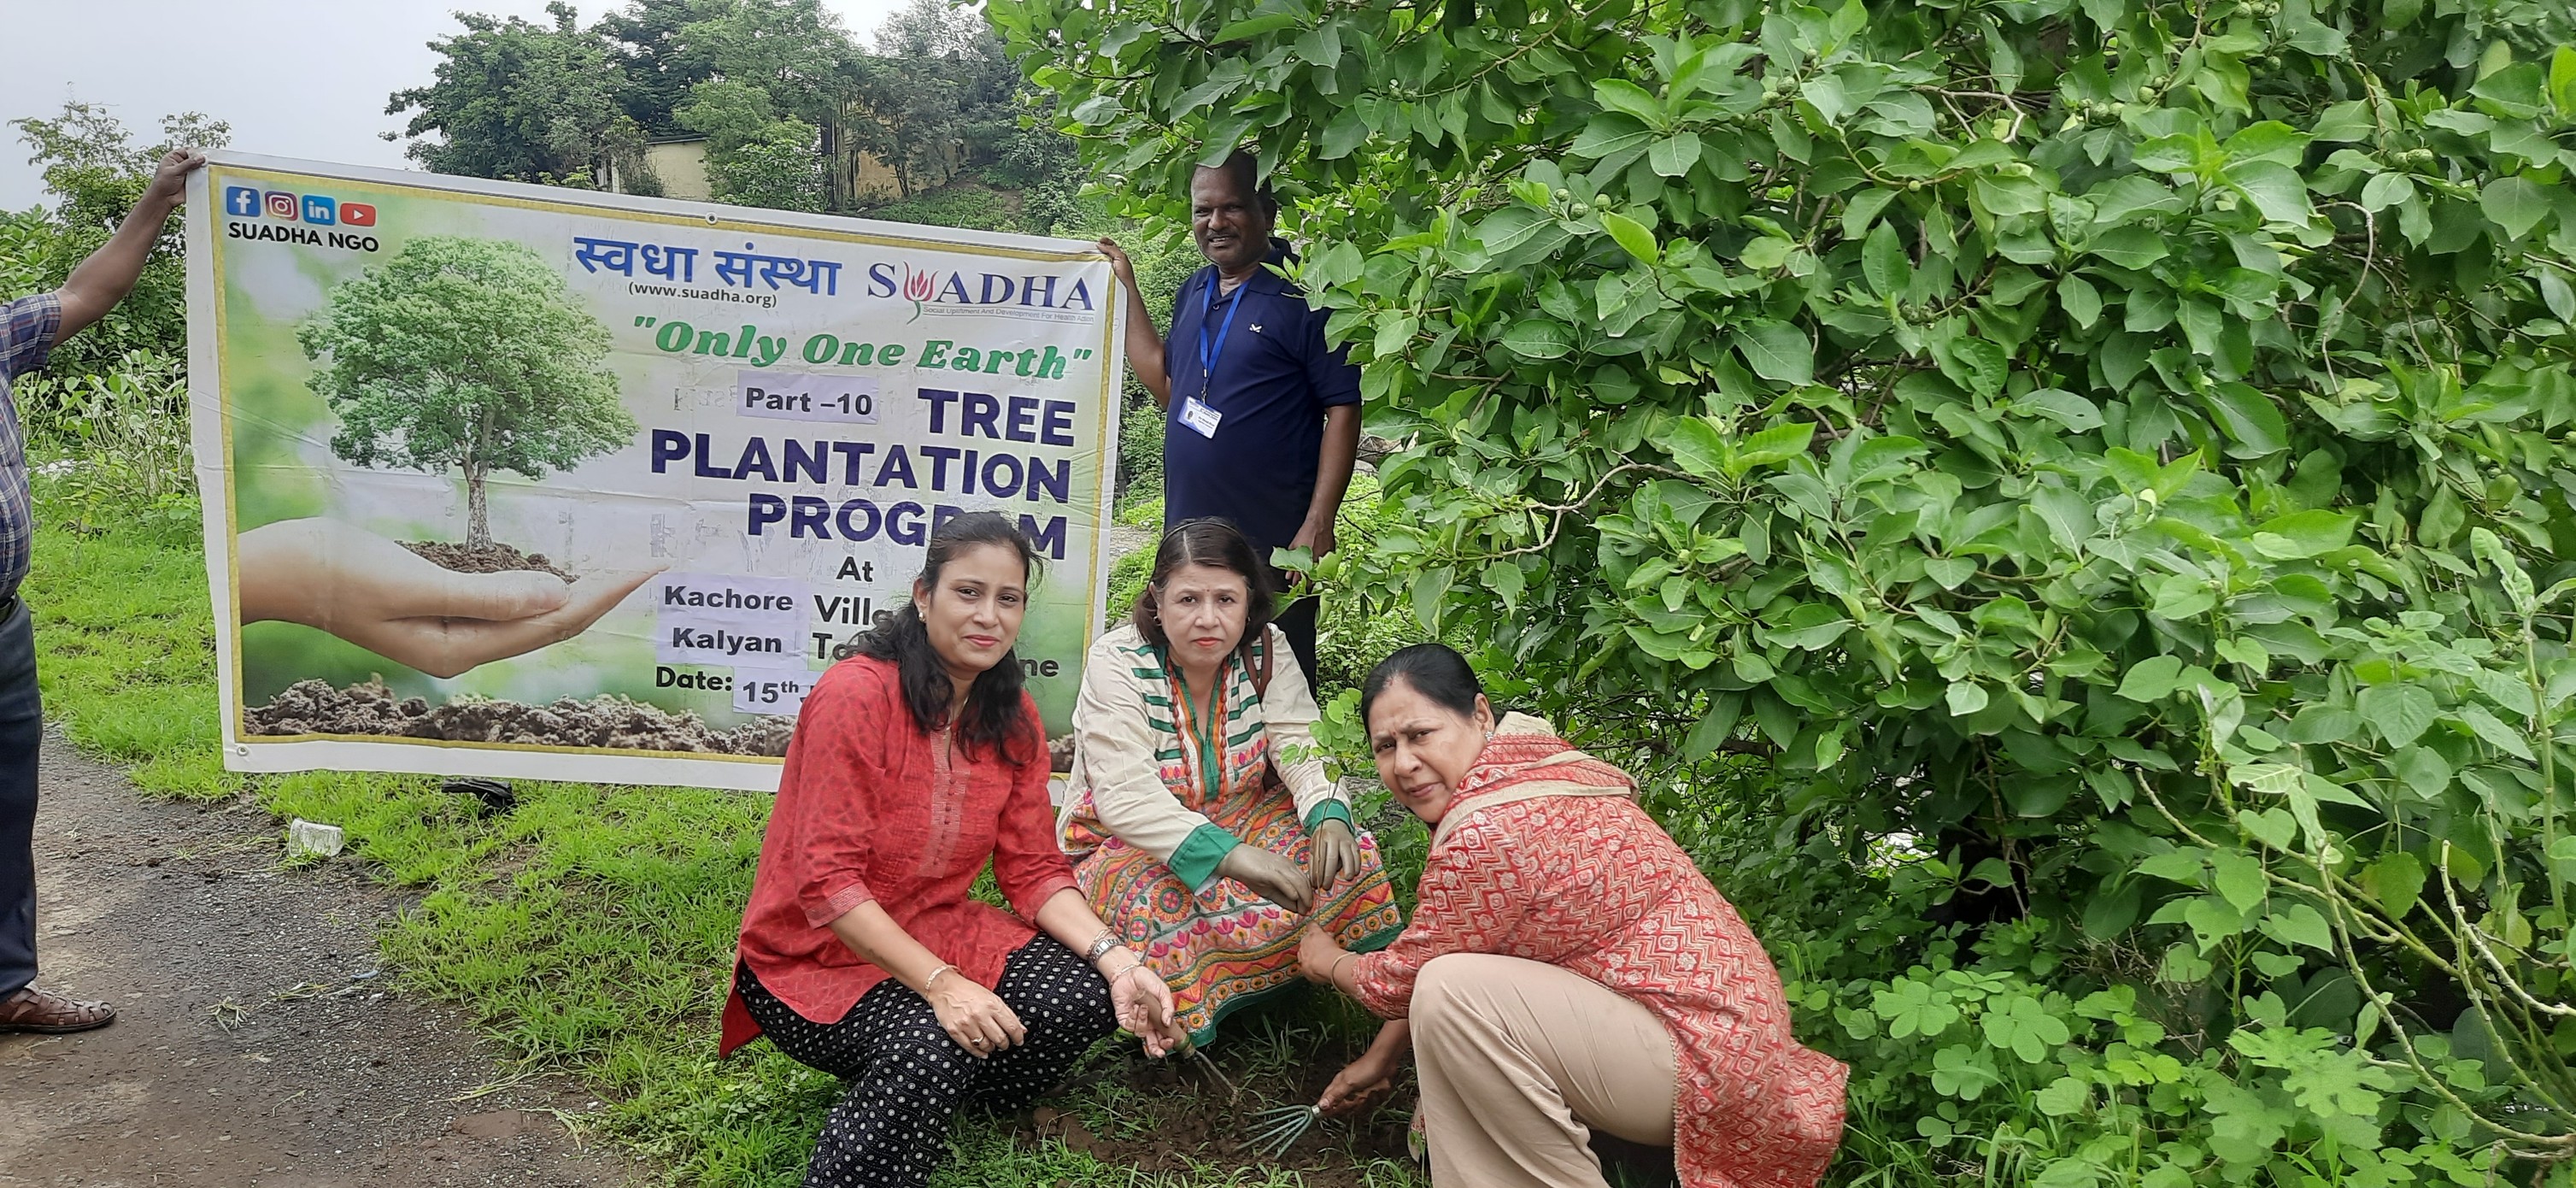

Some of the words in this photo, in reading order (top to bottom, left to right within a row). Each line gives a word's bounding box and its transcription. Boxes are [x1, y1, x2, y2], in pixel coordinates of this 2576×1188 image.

[228, 221, 323, 246] SUADHA
[328, 232, 378, 253] NGO
[573, 236, 699, 283] स्वधा
[712, 241, 842, 297] संस्था
[628, 280, 777, 309] (www.suadha.org)
[995, 309, 1040, 319] Development
[633, 315, 788, 369] "Only
[801, 333, 907, 368] One
[916, 339, 1094, 379] Earth"
[745, 386, 812, 413] Part
[917, 387, 1077, 448] TREE
[651, 428, 1072, 505] PLANTATION
[747, 492, 1068, 562] PROGM
[836, 556, 874, 582] At
[664, 585, 794, 611] Kachore
[672, 626, 783, 656] Kalyan
[655, 666, 733, 692] Date:
[742, 680, 800, 704] 15th
